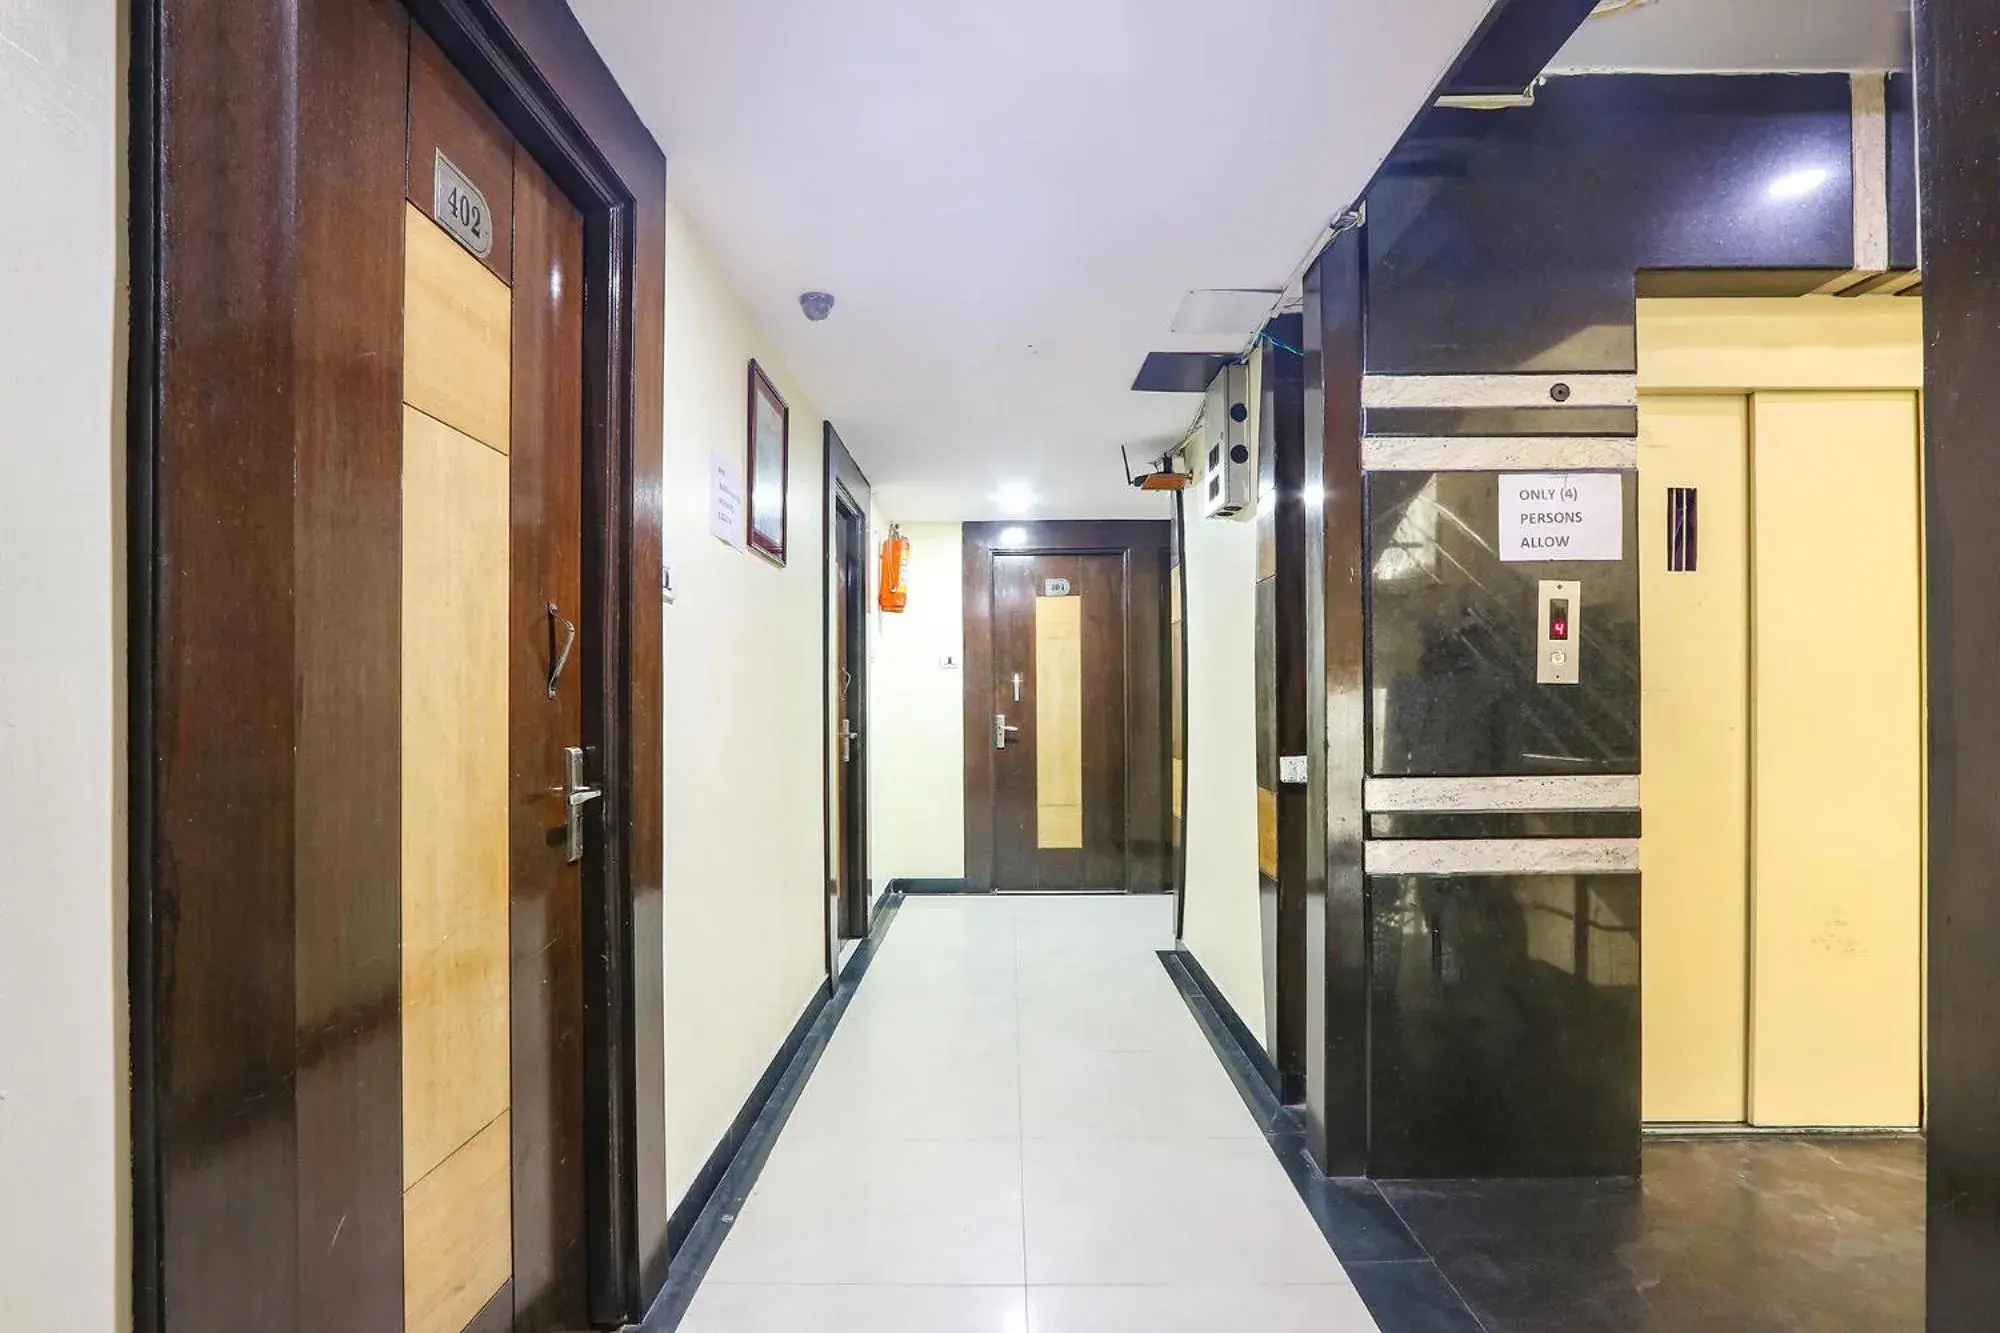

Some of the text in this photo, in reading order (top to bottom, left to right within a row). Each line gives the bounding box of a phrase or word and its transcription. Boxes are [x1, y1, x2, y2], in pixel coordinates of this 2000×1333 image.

[448, 187, 481, 239] 402
[1519, 487, 1578, 501] ONLY (4)
[1520, 512, 1583, 524] PERSONS
[1520, 536, 1570, 548] ALLOW
[1555, 623, 1564, 636] 4
